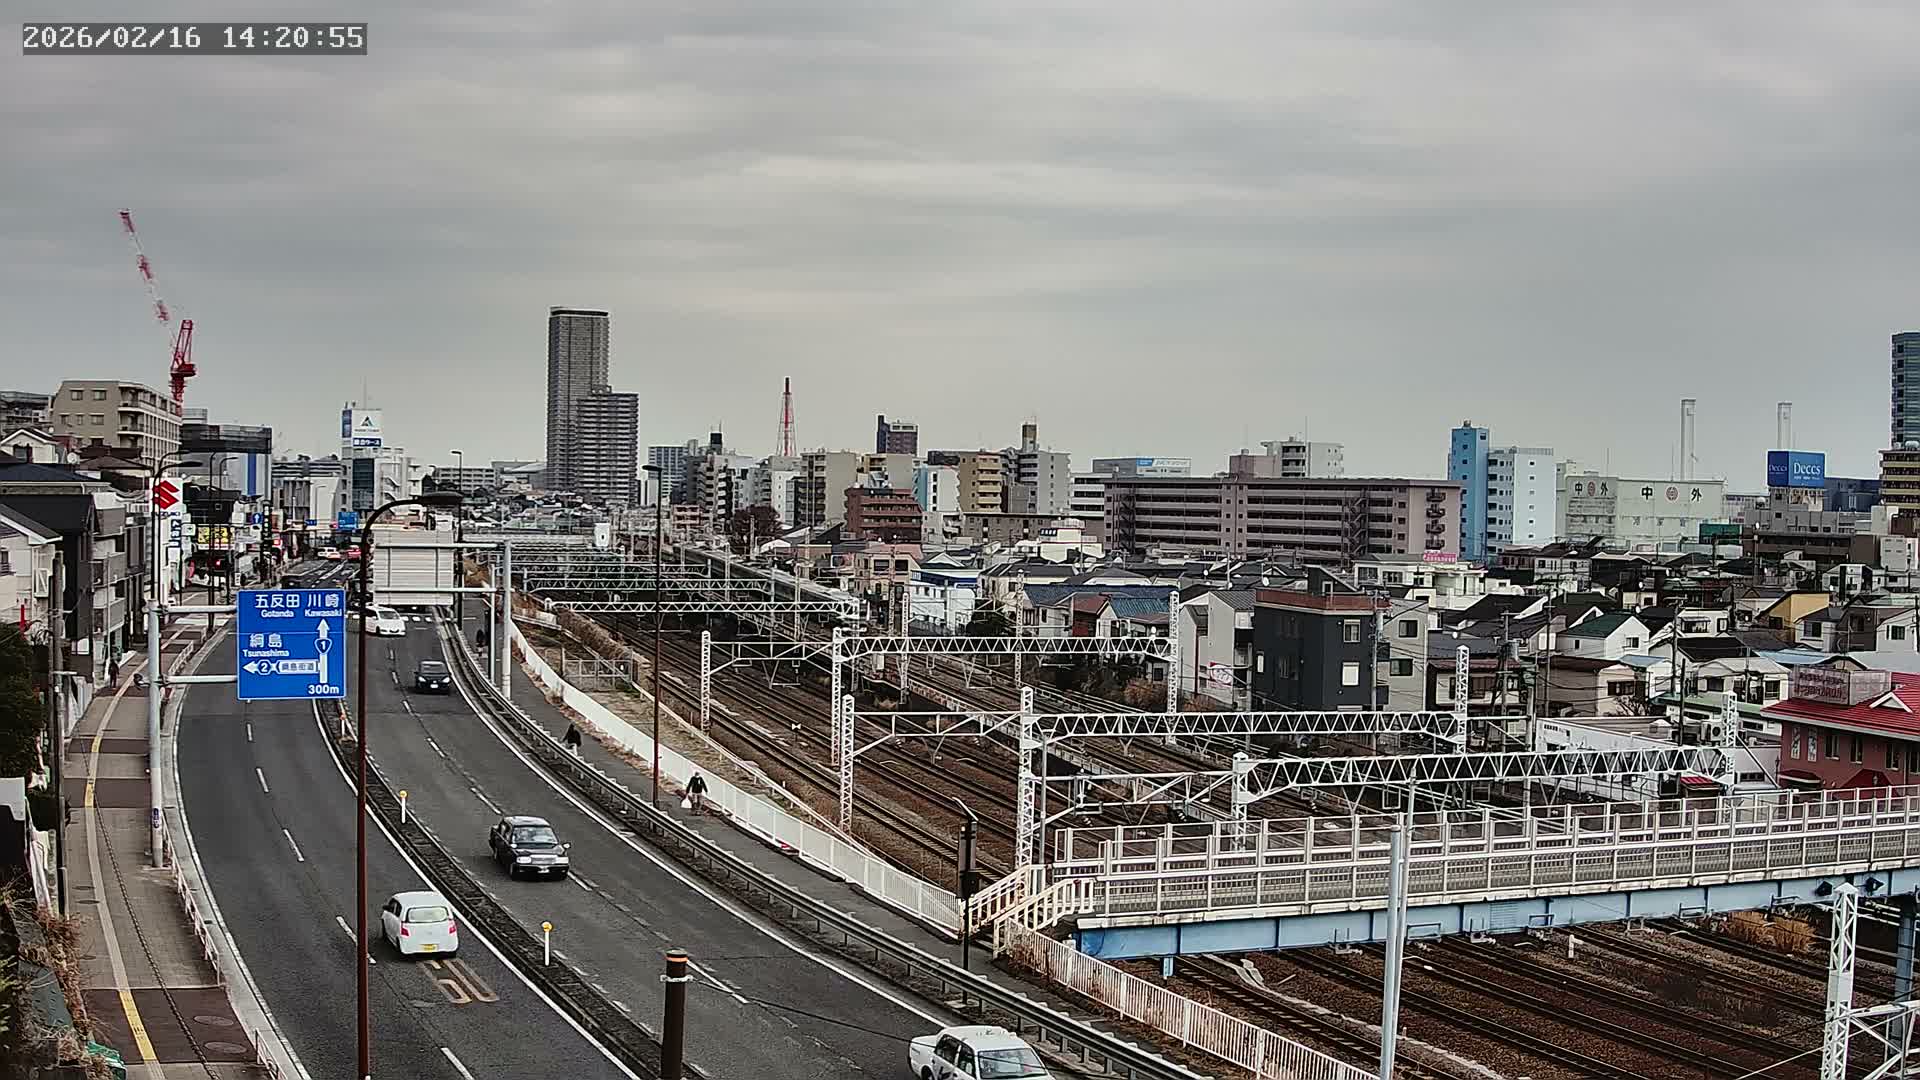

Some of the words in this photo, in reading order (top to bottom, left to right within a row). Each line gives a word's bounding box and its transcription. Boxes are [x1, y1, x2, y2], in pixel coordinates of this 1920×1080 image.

[254, 594, 300, 608] 五反田
[307, 593, 340, 608] 川崎
[261, 609, 295, 618] Gotanda
[304, 608, 342, 617] Kawasaki
[320, 641, 326, 651] 1
[242, 649, 290, 658] Tsunashima
[261, 663, 268, 672] 2
[308, 684, 340, 695] 300m
